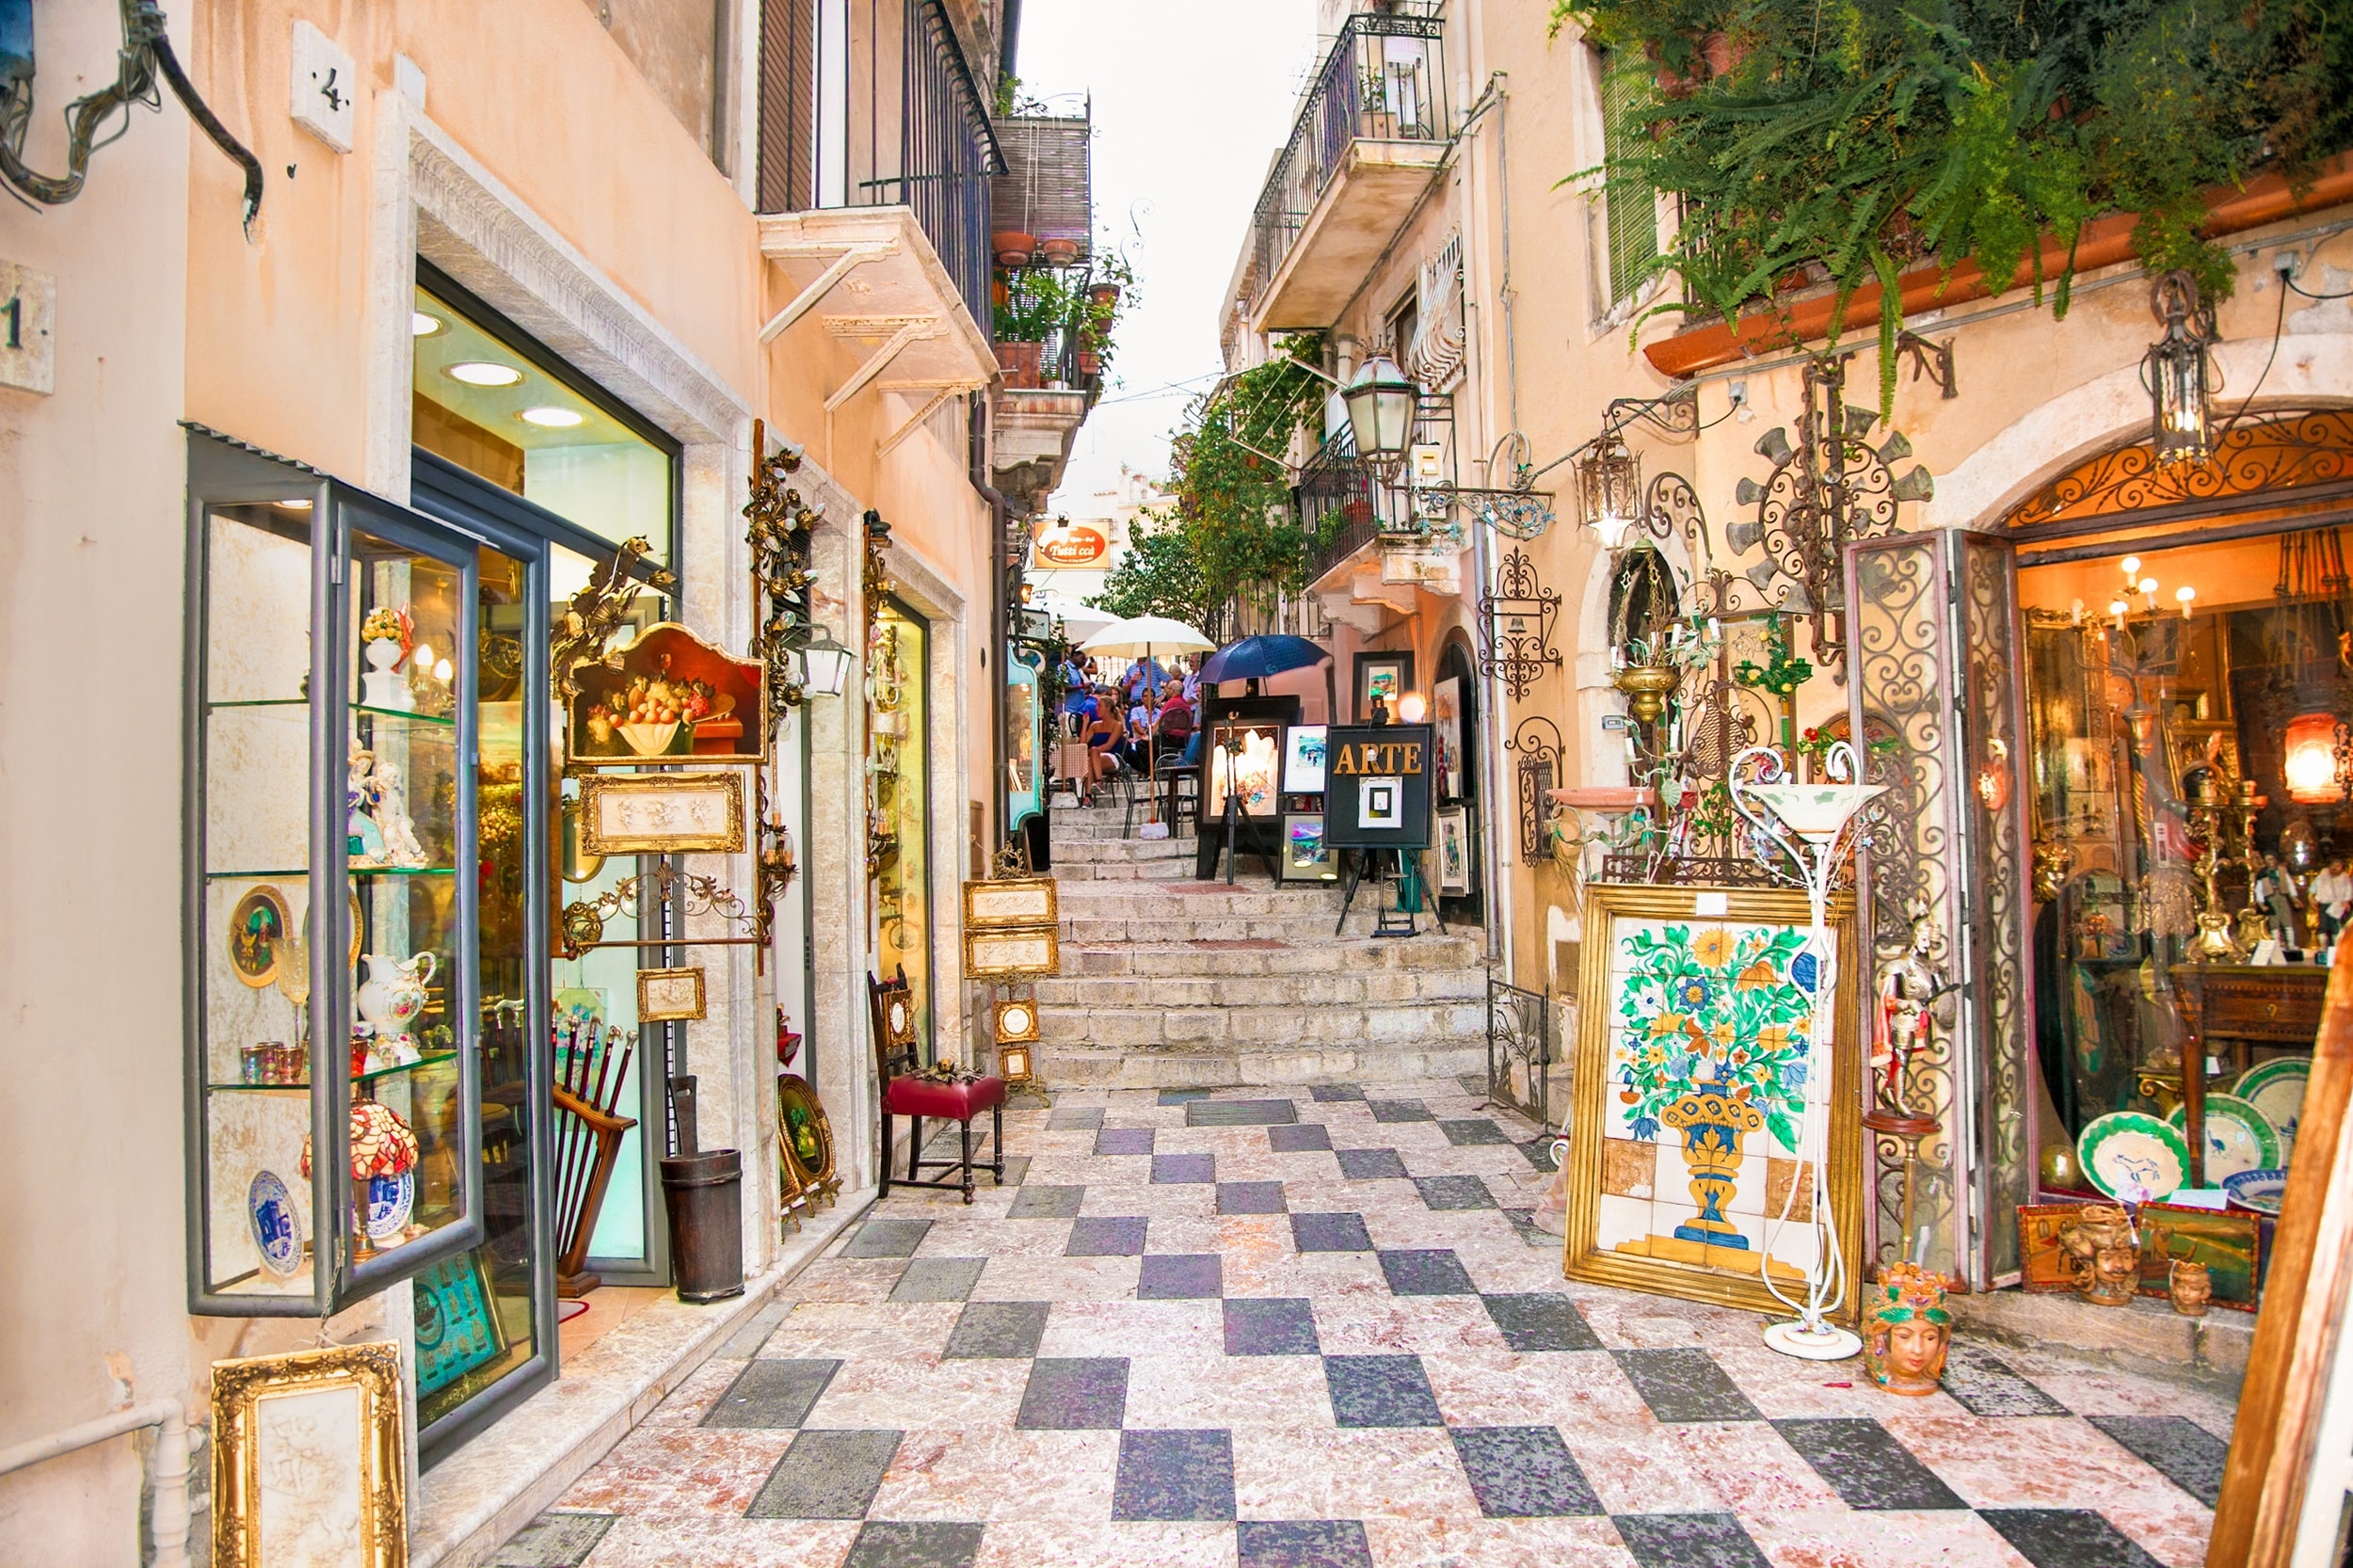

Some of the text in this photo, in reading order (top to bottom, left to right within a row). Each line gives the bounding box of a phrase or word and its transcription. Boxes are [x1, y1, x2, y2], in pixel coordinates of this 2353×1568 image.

[321, 68, 342, 111] 4
[0, 296, 24, 350] 1
[1049, 545, 1077, 556] Tutti
[1333, 743, 1423, 775] ARTE
